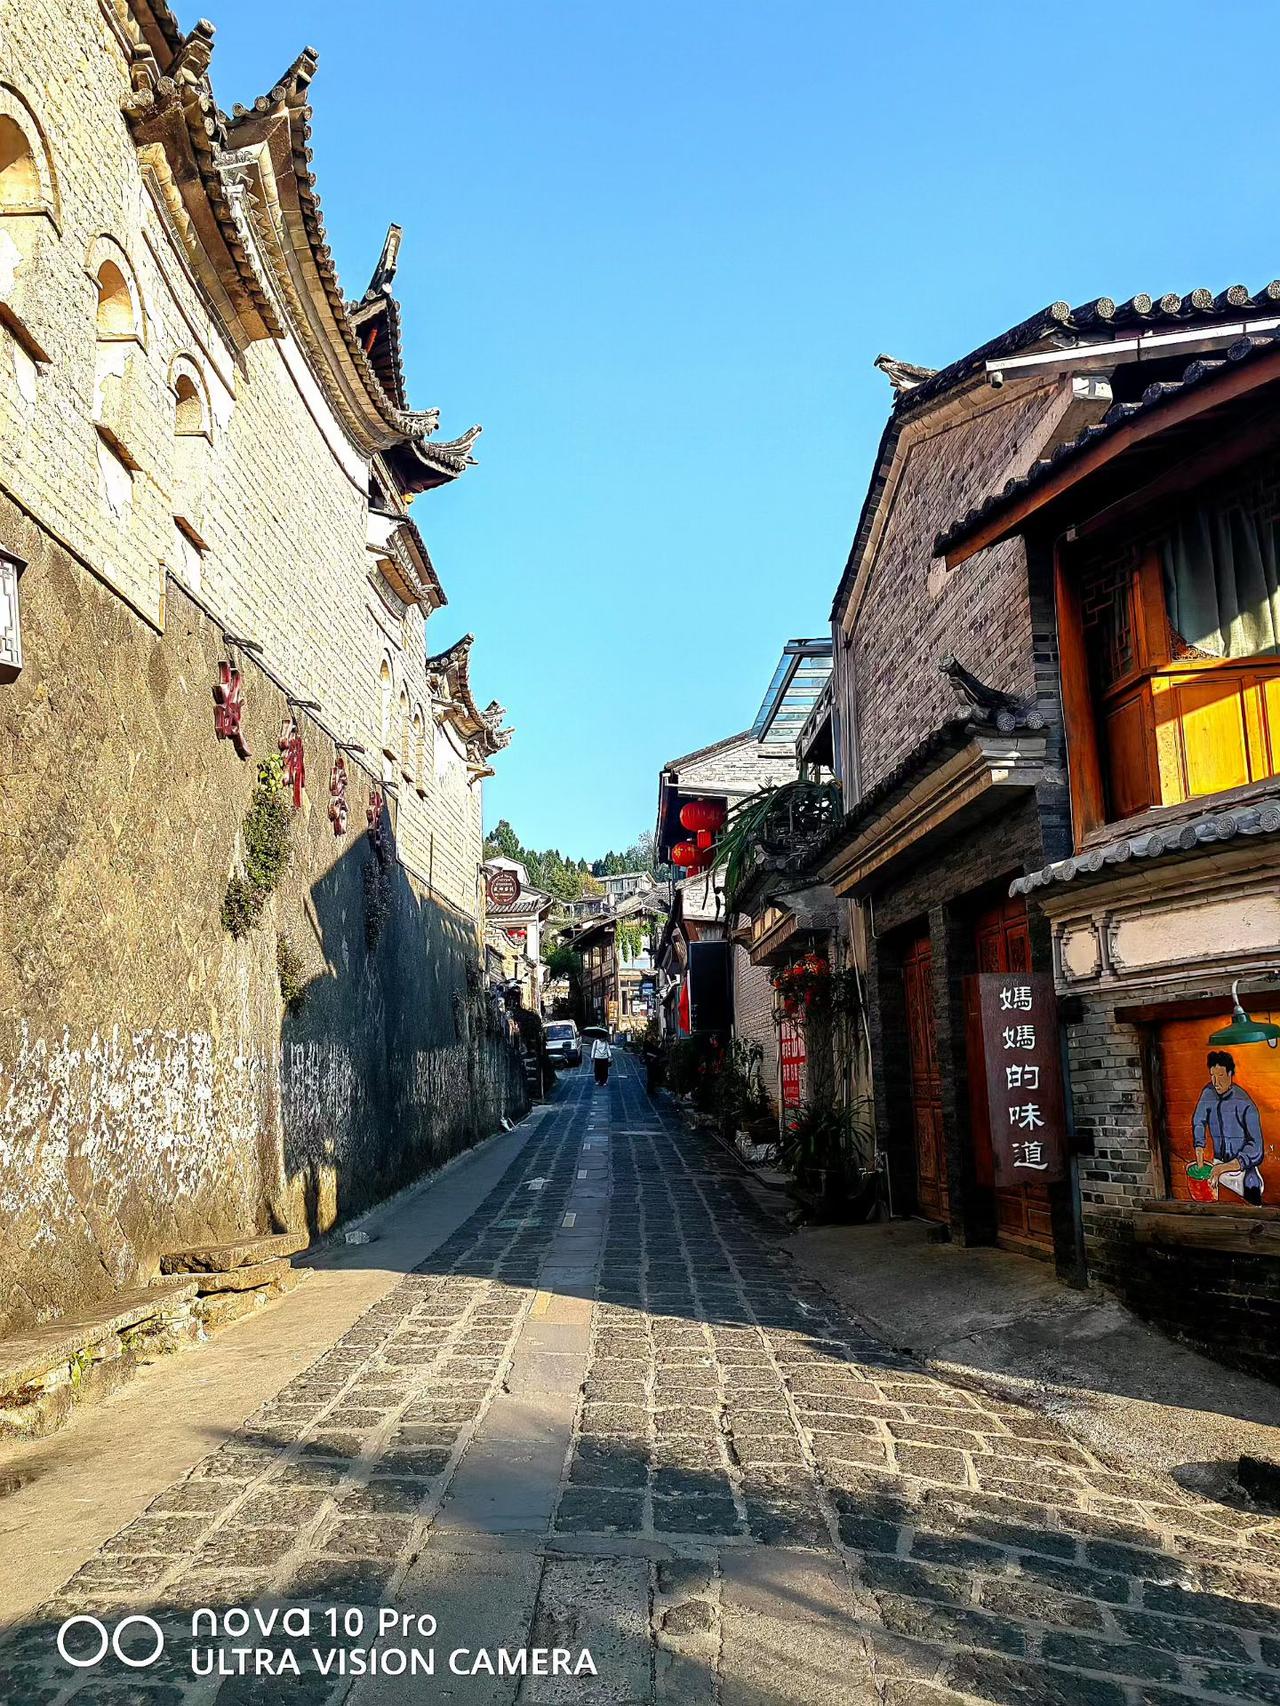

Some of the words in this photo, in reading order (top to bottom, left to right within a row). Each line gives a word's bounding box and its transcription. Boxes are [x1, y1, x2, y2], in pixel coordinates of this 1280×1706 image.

[1000, 986, 1049, 1171] 媽媽的味道
